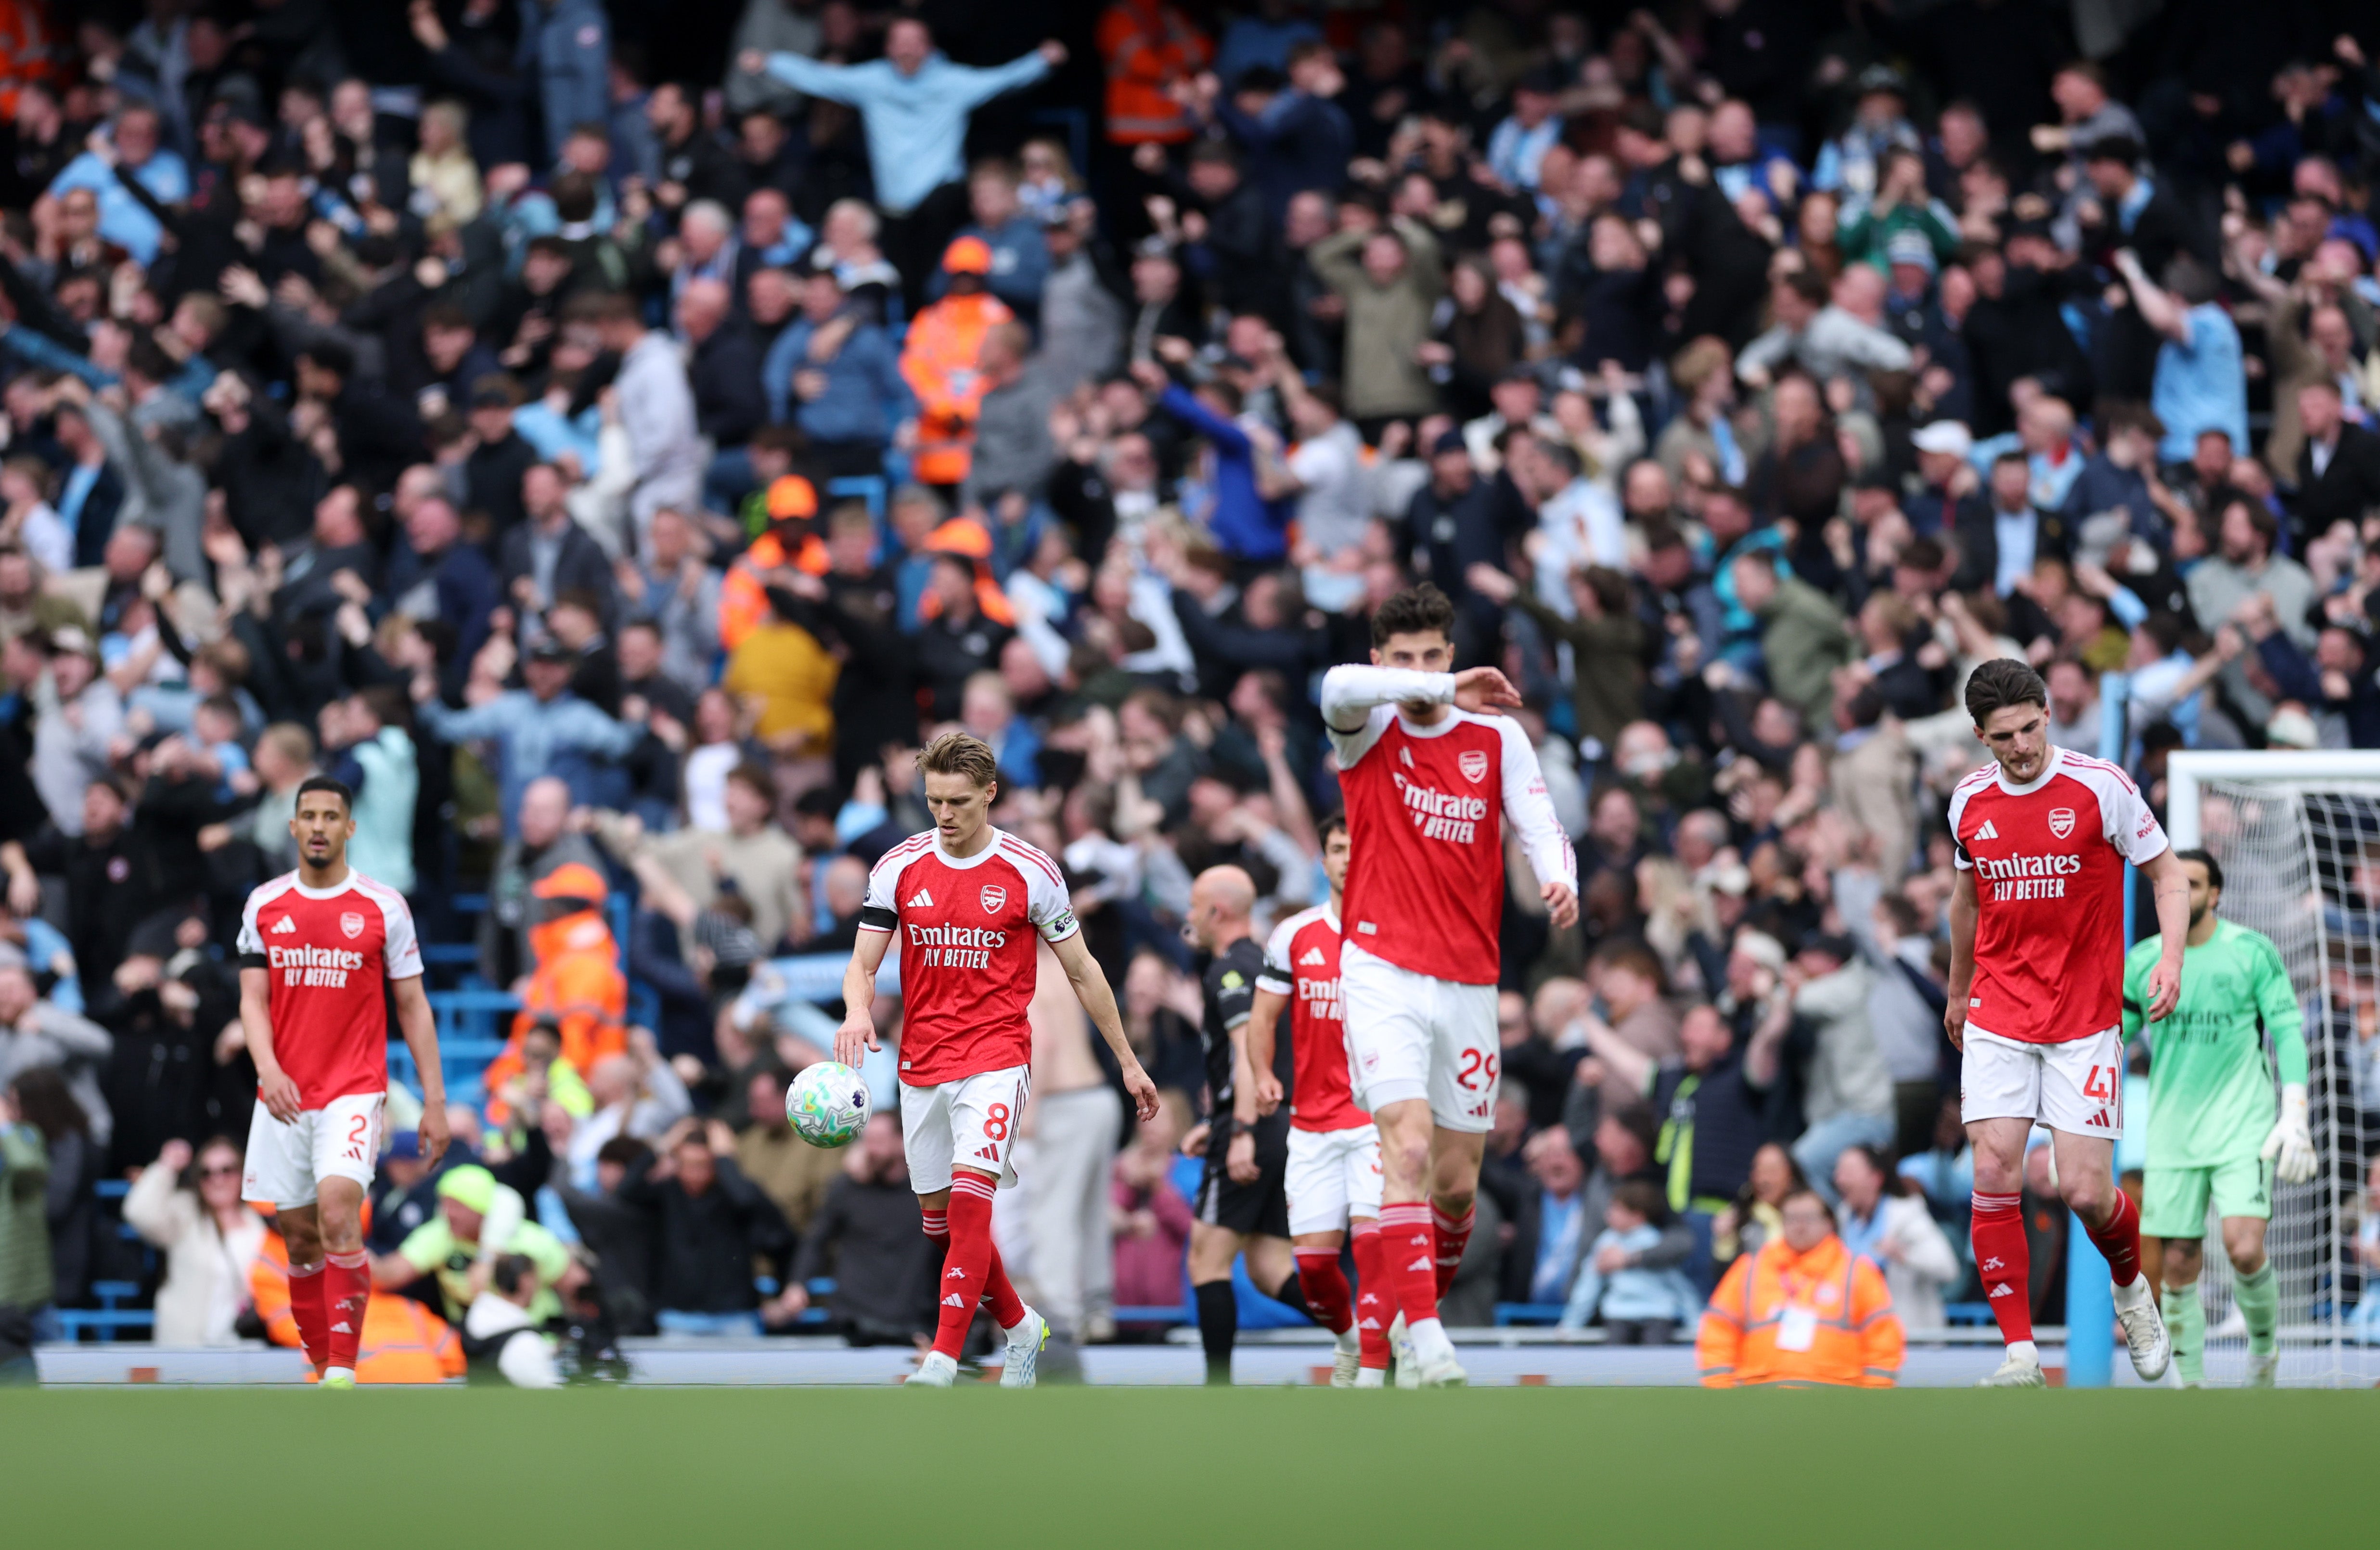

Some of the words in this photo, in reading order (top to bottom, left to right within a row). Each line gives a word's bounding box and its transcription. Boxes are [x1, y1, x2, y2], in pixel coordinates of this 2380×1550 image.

[1975, 852, 2081, 880] Emirates
[1994, 880, 2014, 902] FLY
[2016, 878, 2065, 900] BETTER
[907, 922, 1005, 948] Emirates
[269, 943, 363, 970] Emirates
[924, 947, 939, 967] FLY
[943, 948, 990, 969] BETTER
[284, 968, 303, 987] FLY
[304, 968, 348, 989] BETTER
[1457, 1047, 1498, 1093] 29
[2083, 1064, 2117, 1106] 41
[348, 1114, 367, 1146] 2
[983, 1103, 1009, 1141] 8
